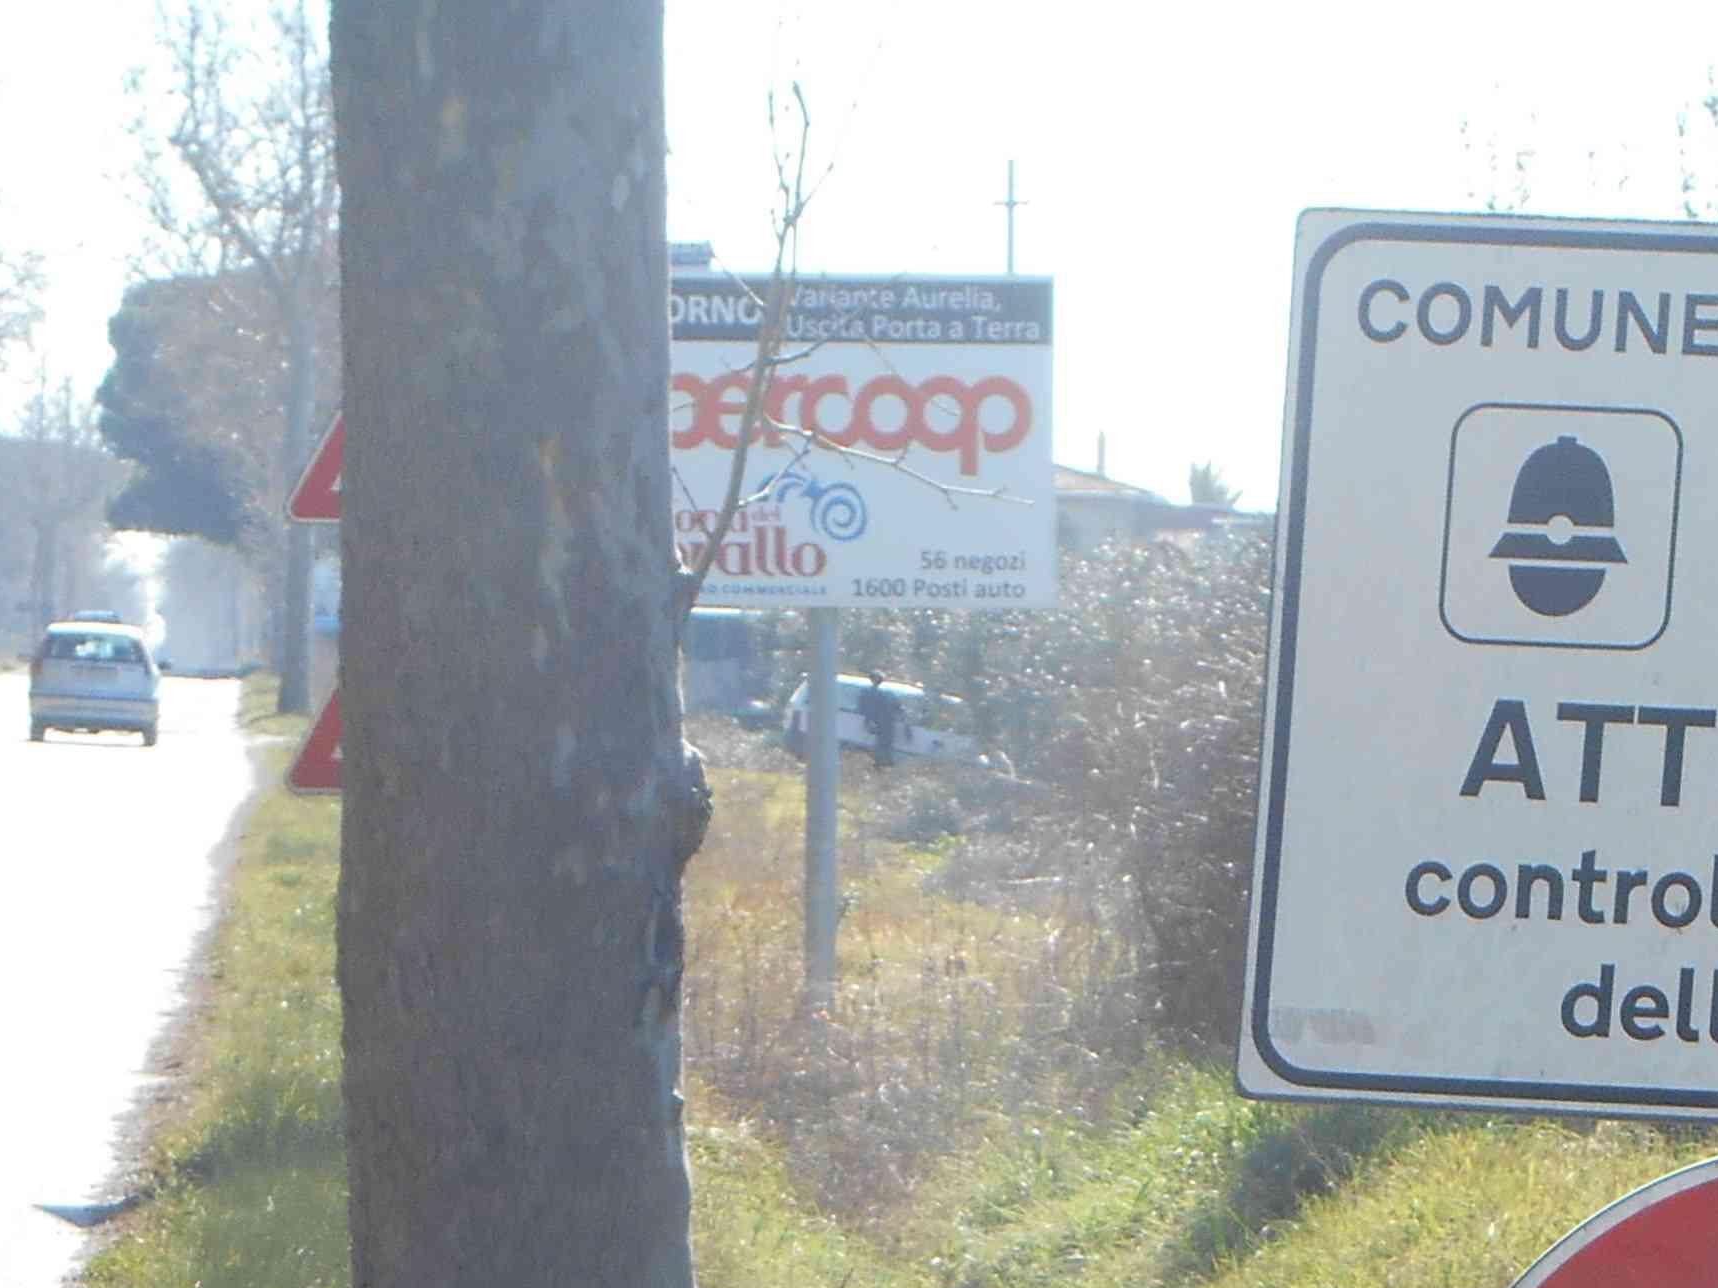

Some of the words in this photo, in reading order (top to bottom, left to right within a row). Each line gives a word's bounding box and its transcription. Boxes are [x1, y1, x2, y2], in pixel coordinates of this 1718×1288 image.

[873, 316, 941, 338] Porta
[947, 322, 963, 338] a
[970, 316, 1040, 339] Terra
[920, 551, 948, 570] 56
[954, 551, 1026, 575] negozi
[851, 579, 907, 598] 1600
[914, 578, 968, 598] Posti
[974, 580, 1026, 598] auto
